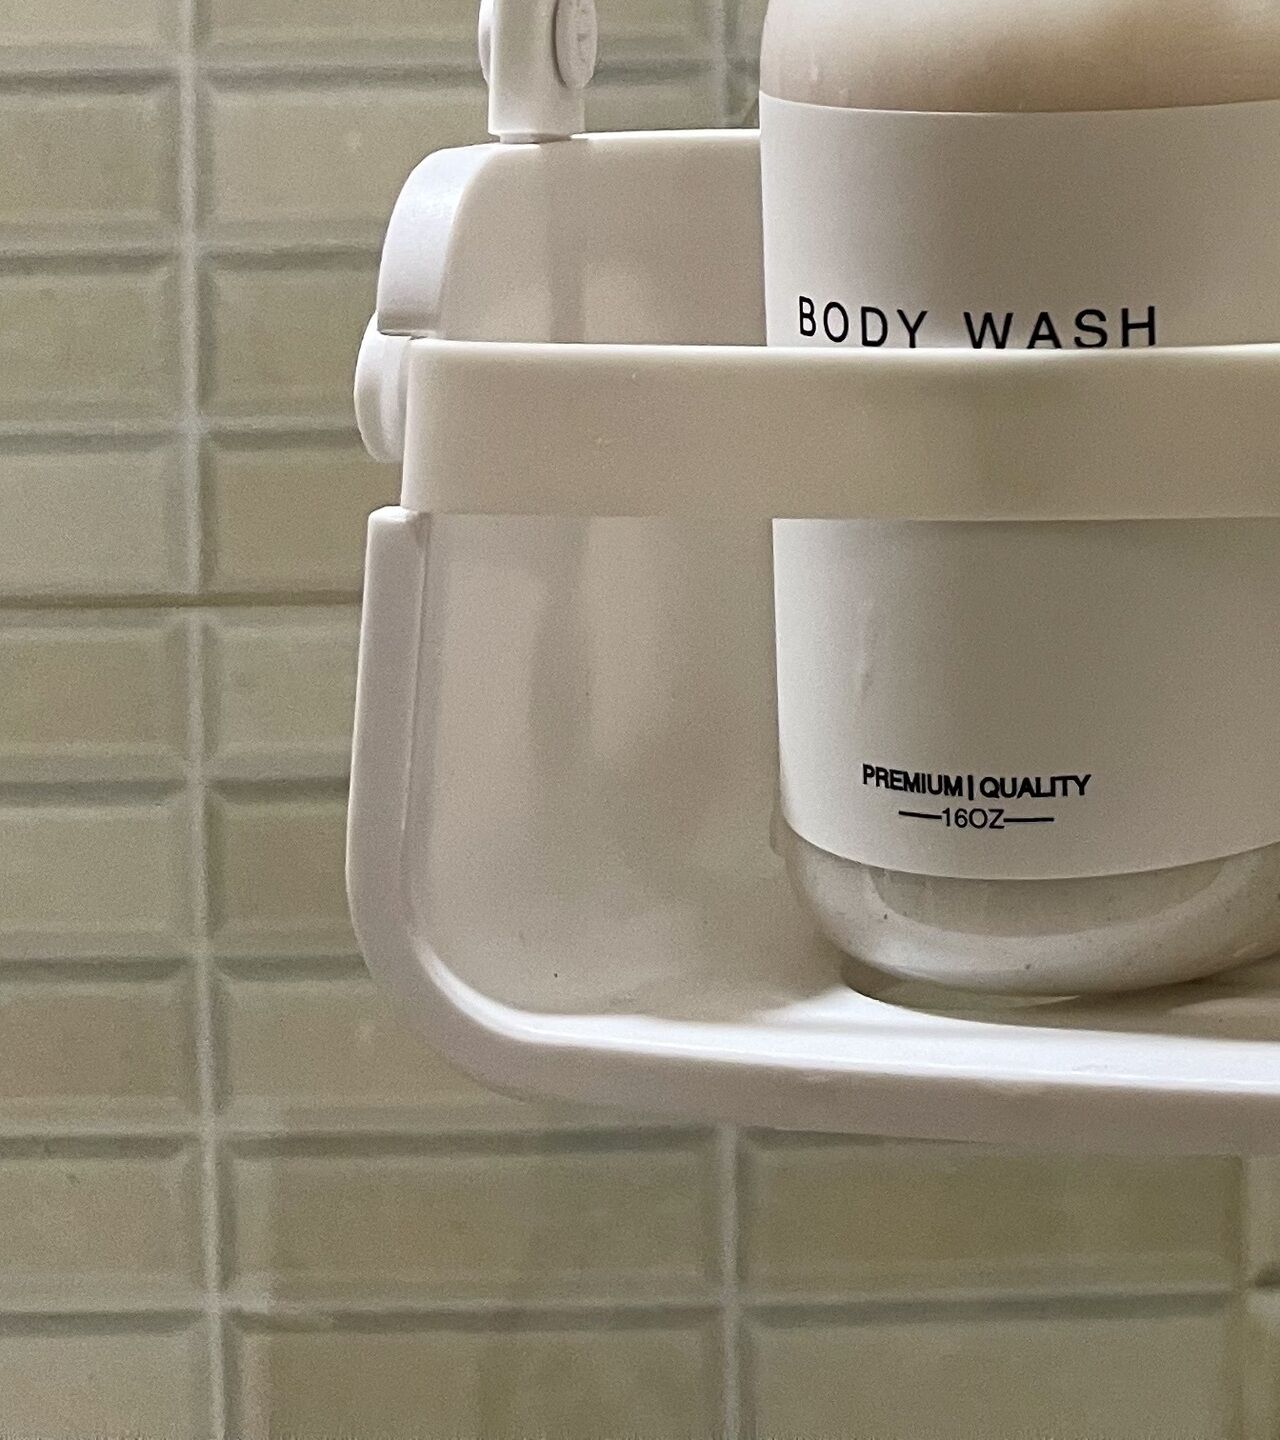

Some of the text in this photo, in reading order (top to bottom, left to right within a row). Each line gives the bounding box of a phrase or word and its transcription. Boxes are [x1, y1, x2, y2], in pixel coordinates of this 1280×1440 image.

[799, 296, 1157, 349] BODY WASH
[942, 808, 1005, 829] 16OZ
